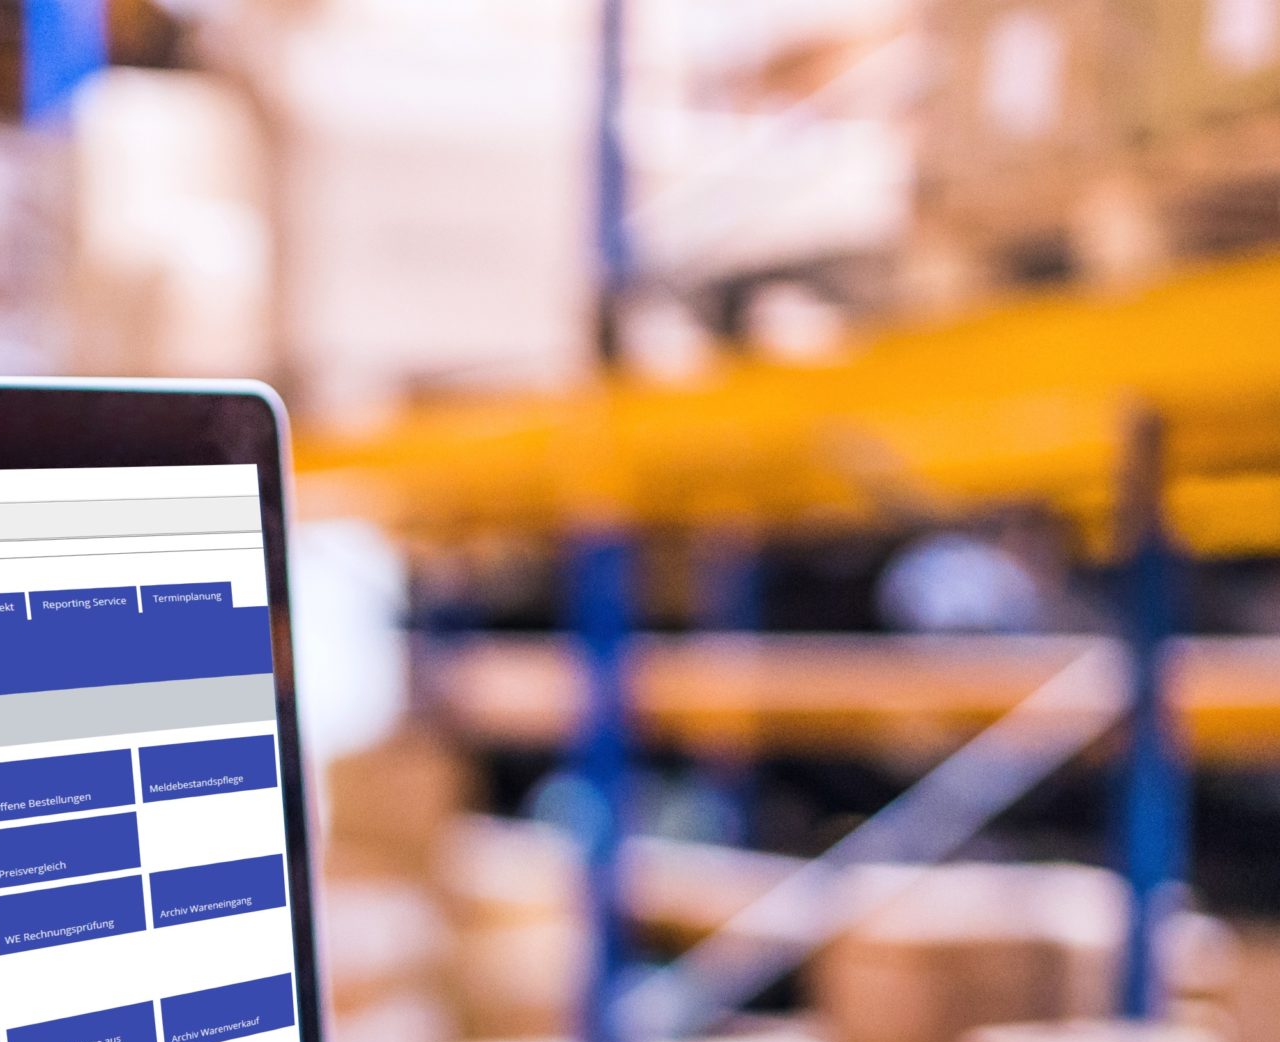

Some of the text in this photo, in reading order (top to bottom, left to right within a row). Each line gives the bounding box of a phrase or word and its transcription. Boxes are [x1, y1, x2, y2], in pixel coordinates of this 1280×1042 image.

[42, 597, 127, 611] Reporting Service
[153, 593, 222, 603] Terminplanung
[149, 776, 243, 793] Meldebestandspflege
[28, 794, 91, 808] Bestellungen
[160, 897, 252, 918] Archiv Wareneingang
[4, 920, 115, 944] WE Rechnungsprüfung
[171, 1016, 259, 1042] Archiv Warenverkauf
